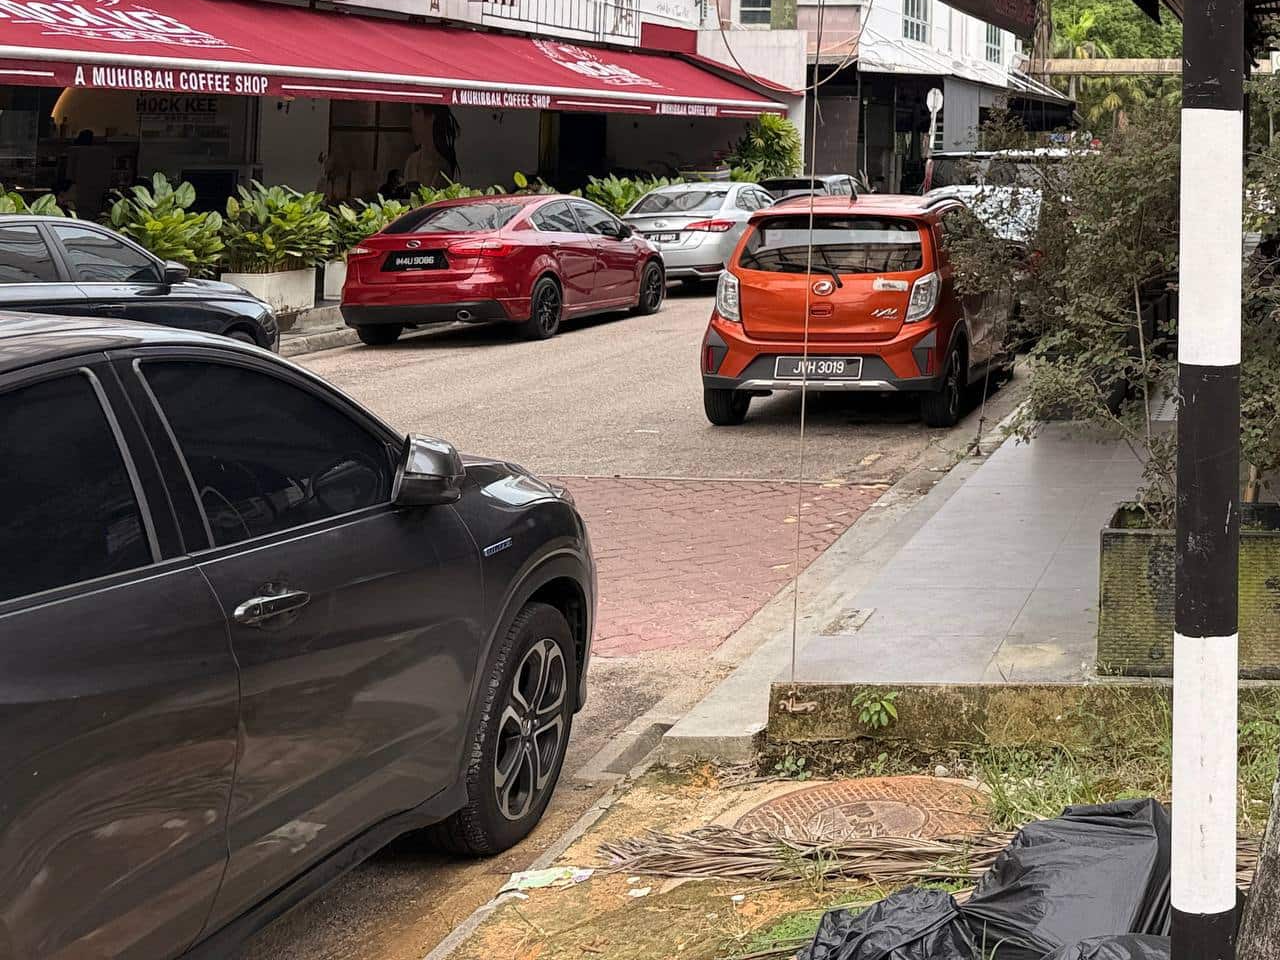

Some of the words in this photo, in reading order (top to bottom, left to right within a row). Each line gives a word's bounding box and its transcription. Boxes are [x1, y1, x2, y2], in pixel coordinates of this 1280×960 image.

[74, 65, 86, 86] A
[92, 67, 174, 90] MUHIBBAH
[179, 71, 231, 92] COFFEE
[234, 76, 269, 94] SHOP
[452, 89, 459, 105] A
[460, 90, 502, 106] MUHIBBAH
[503, 93, 531, 107] COFFEE
[531, 95, 551, 109] SHOP
[817, 361, 845, 374] 3019
